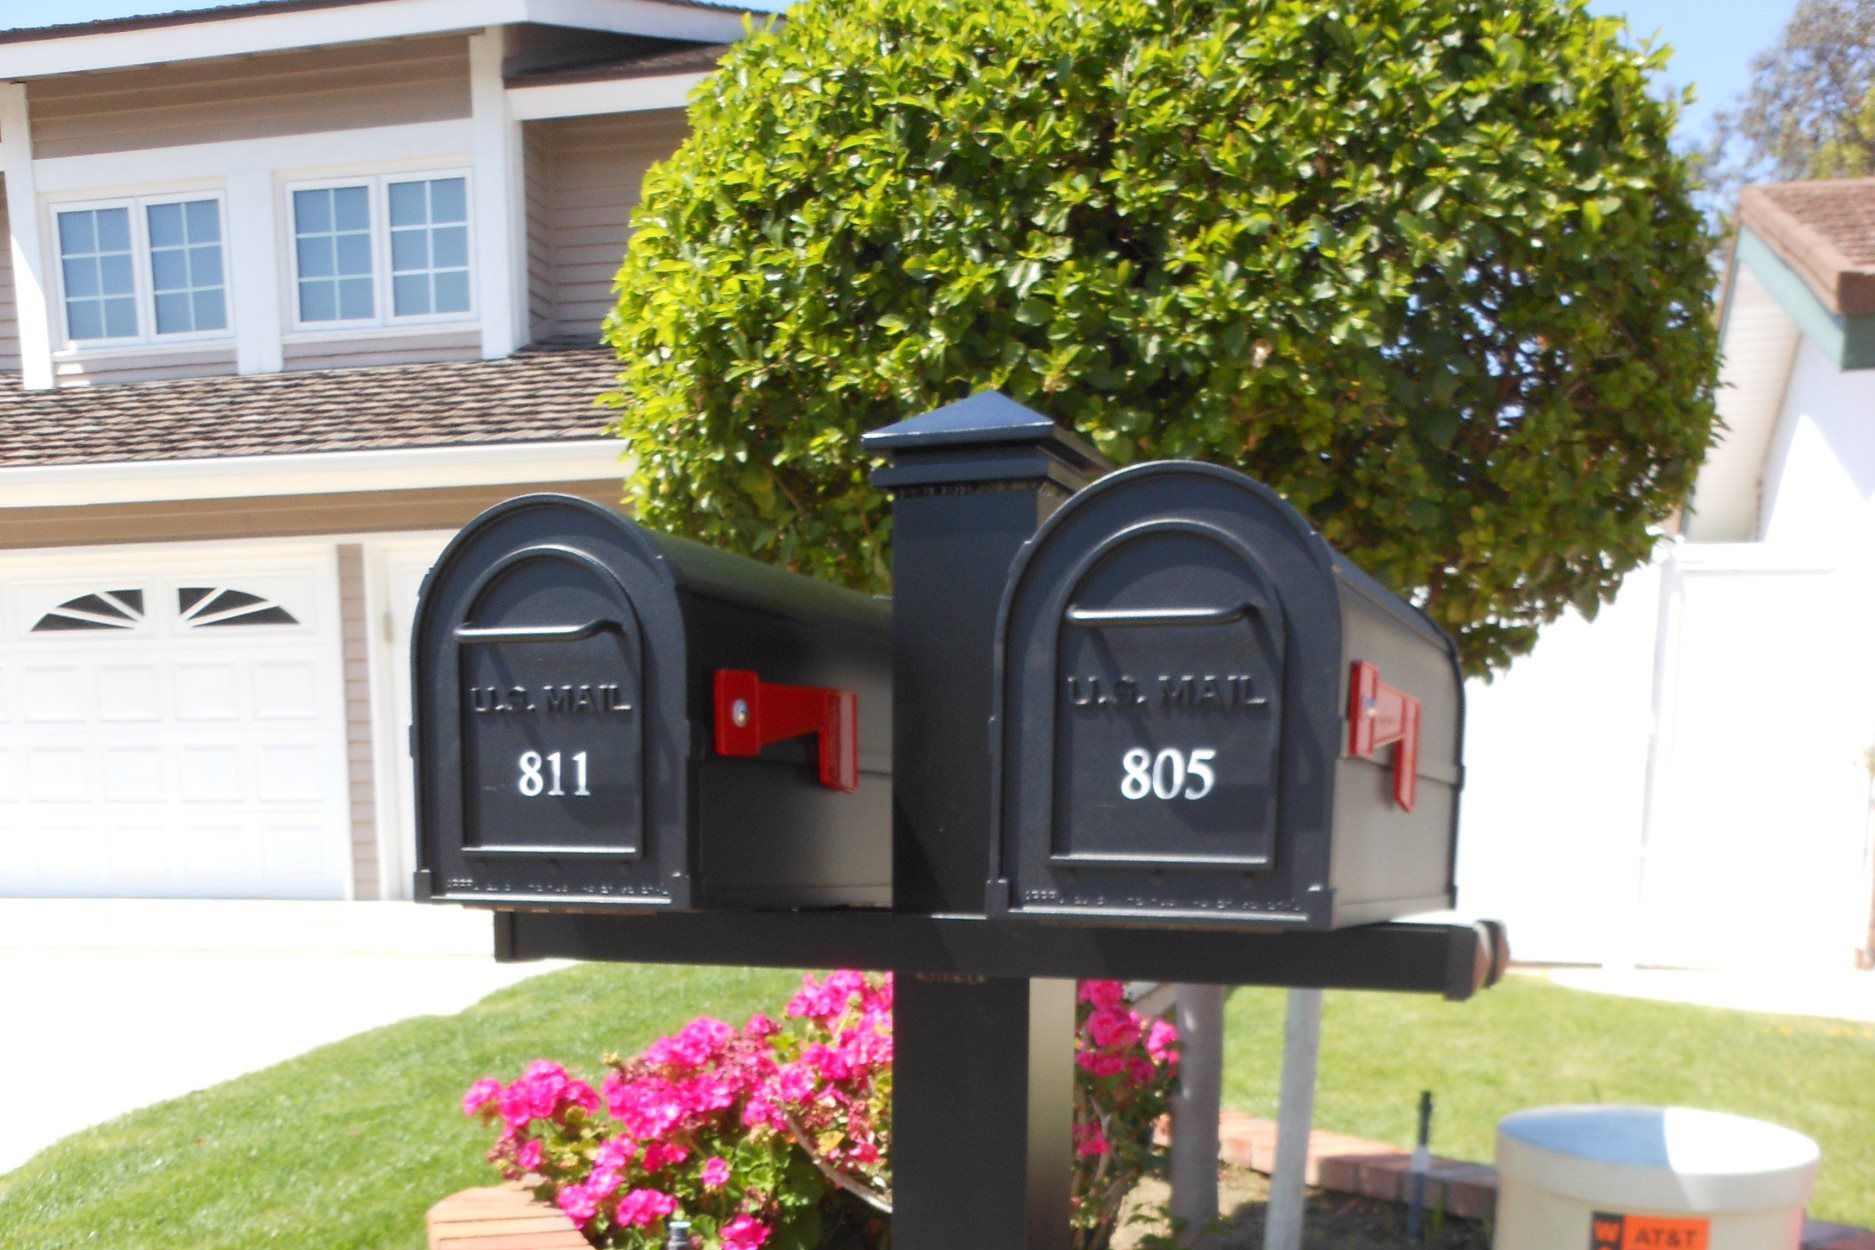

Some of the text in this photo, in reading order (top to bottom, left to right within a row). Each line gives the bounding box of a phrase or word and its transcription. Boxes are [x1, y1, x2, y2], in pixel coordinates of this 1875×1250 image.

[469, 684, 632, 713] U.S. MAIL
[1067, 674, 1268, 707] U.S. MAIL
[518, 751, 592, 797] 811
[1121, 747, 1217, 801] 805
[1633, 1228, 1697, 1249] AT&T
